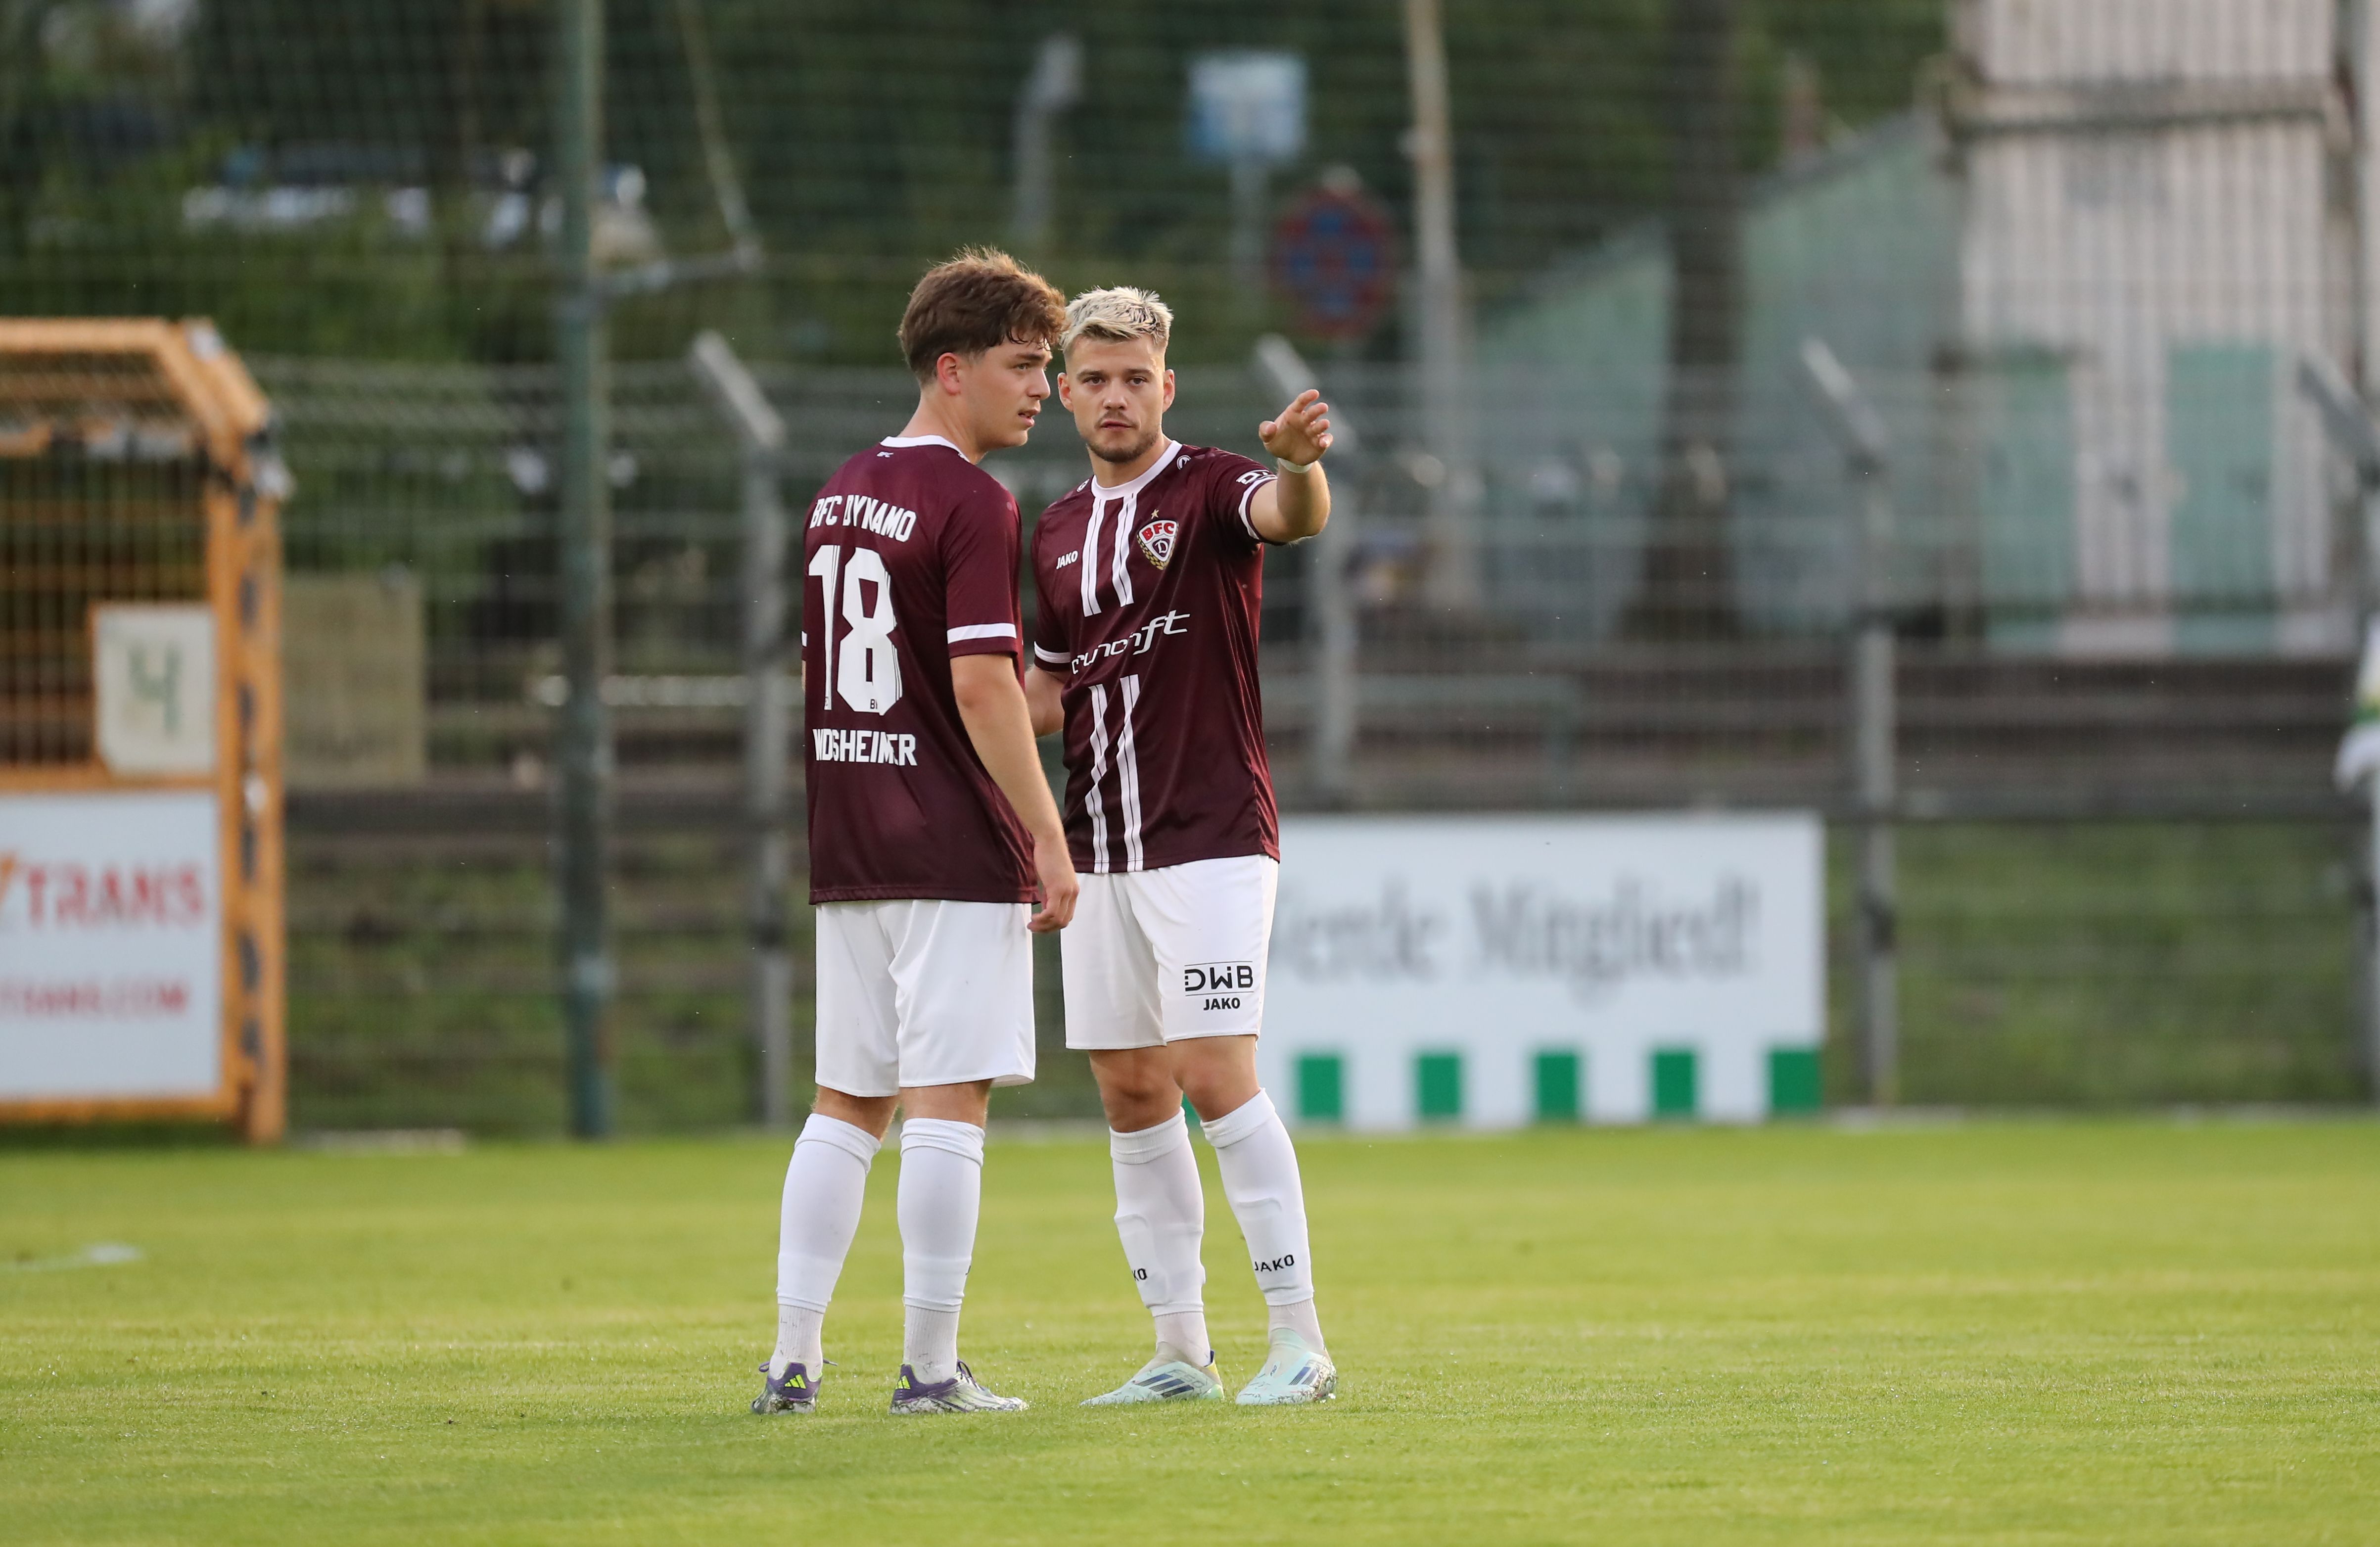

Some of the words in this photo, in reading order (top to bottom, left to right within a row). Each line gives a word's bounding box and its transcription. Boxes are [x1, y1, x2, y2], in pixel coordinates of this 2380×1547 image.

[809, 495, 842, 529] BFC
[842, 495, 917, 543] DYNAMO
[1142, 522, 1174, 541] BFC
[1056, 551, 1078, 569] JAKO
[808, 545, 903, 716] 18
[1203, 997, 1240, 1011] JAKO
[1255, 1255, 1295, 1272] JAKO
